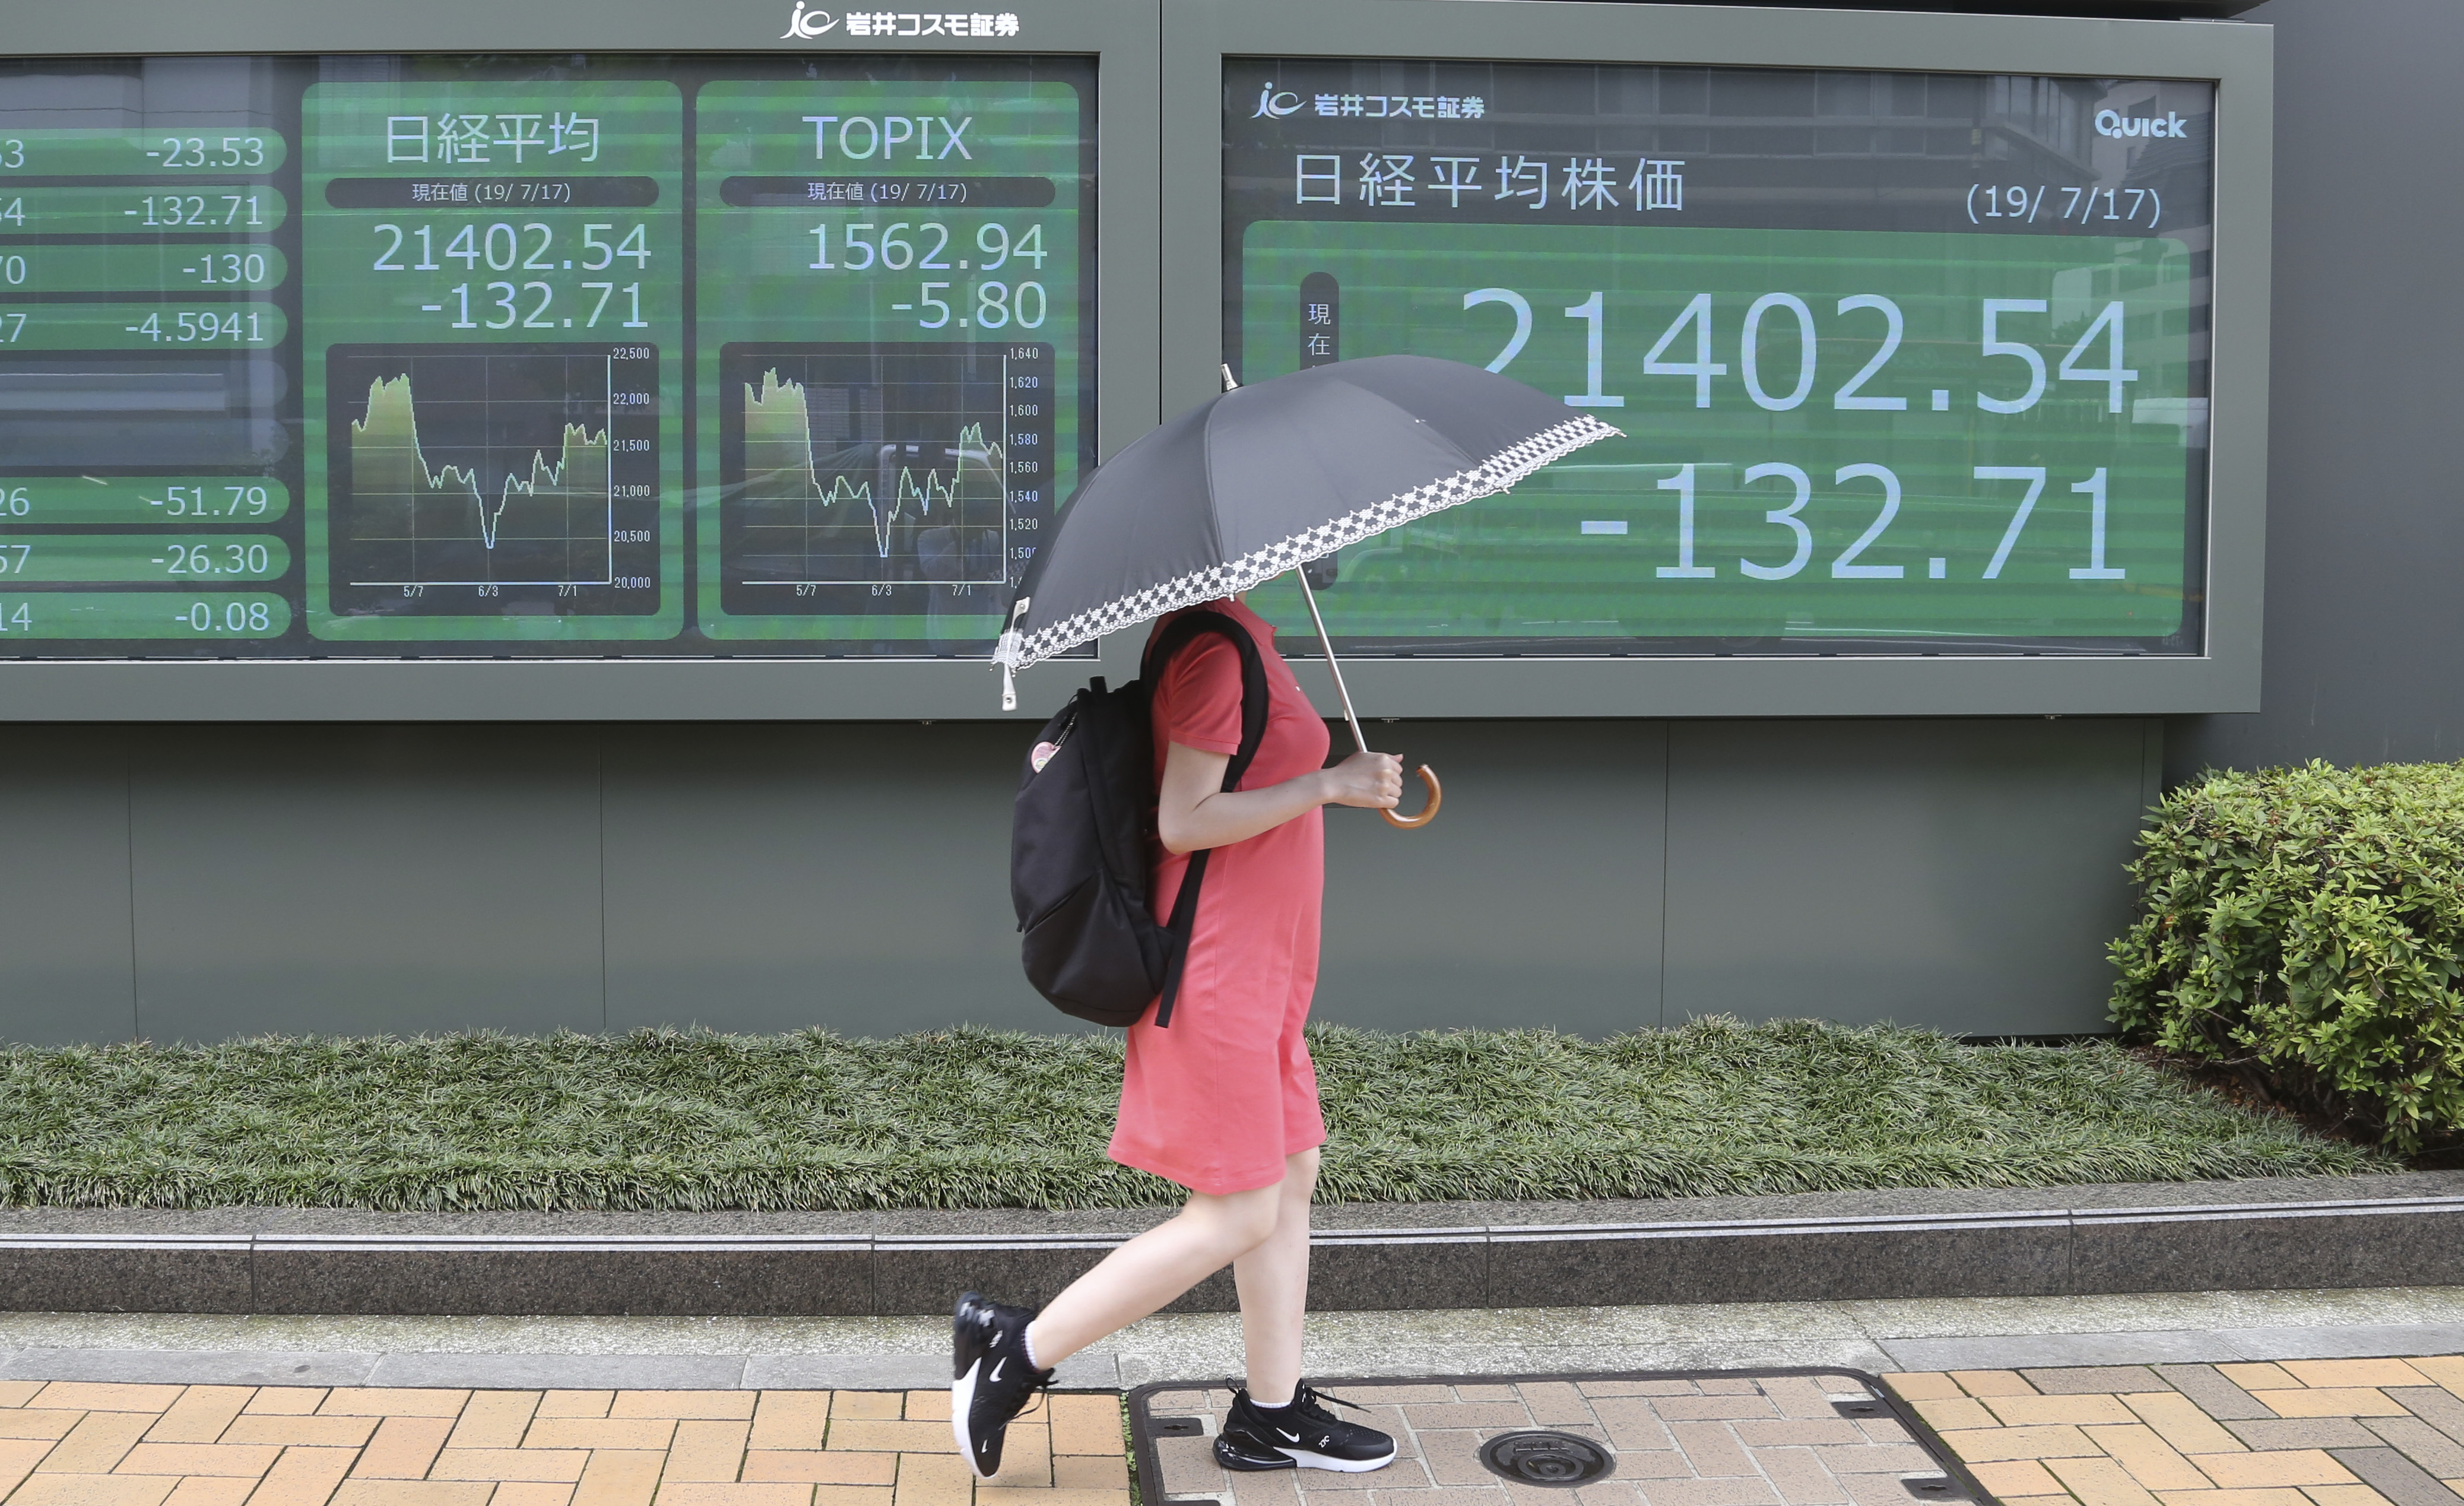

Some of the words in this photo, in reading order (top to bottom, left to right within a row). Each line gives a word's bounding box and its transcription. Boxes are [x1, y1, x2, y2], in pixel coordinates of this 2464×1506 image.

[846, 12, 1019, 36] 岩井コスモ証券
[1315, 94, 1484, 118] 岩井コスモ証券
[388, 112, 598, 163] 日経平均
[803, 116, 972, 159] TOPIX
[147, 138, 263, 166] -23.53
[413, 183, 467, 201] 現在値
[808, 182, 863, 199] 現在値
[1297, 153, 1685, 211] 日経平均株価
[125, 196, 262, 224] -132.71
[374, 223, 651, 270] 21402.54
[810, 223, 1047, 270] 1562.94
[183, 254, 264, 283] -130
[422, 282, 648, 329] -132.71
[892, 281, 1045, 328] -5.80
[126, 312, 263, 341] -4.5941
[614, 348, 649, 360] 22,500
[1011, 348, 1038, 360] 1,640
[1463, 287, 2138, 414] 21402.54
[1010, 377, 1037, 388] 1,620
[614, 393, 649, 405] 22,000
[1010, 405, 1038, 417] 1,600
[614, 440, 649, 452] 21,500
[1010, 434, 1037, 445] 1,580
[1010, 462, 1037, 474] 1,560
[151, 487, 266, 515] -51.79
[614, 486, 649, 497] 21,000
[1010, 491, 1037, 503] 1,540
[1010, 518, 1037, 531] 1,520
[1581, 462, 2125, 580] -132.71
[614, 531, 649, 543] 20,500
[152, 545, 267, 573] -26.30
[404, 586, 423, 597] 5/7
[479, 586, 497, 596] 6/3
[559, 586, 576, 596] 7/1
[615, 577, 650, 589] 20,000
[797, 584, 816, 595] 5/7
[873, 585, 891, 595] 6/3
[953, 584, 970, 595] 7/1
[176, 603, 268, 630] -0.08
